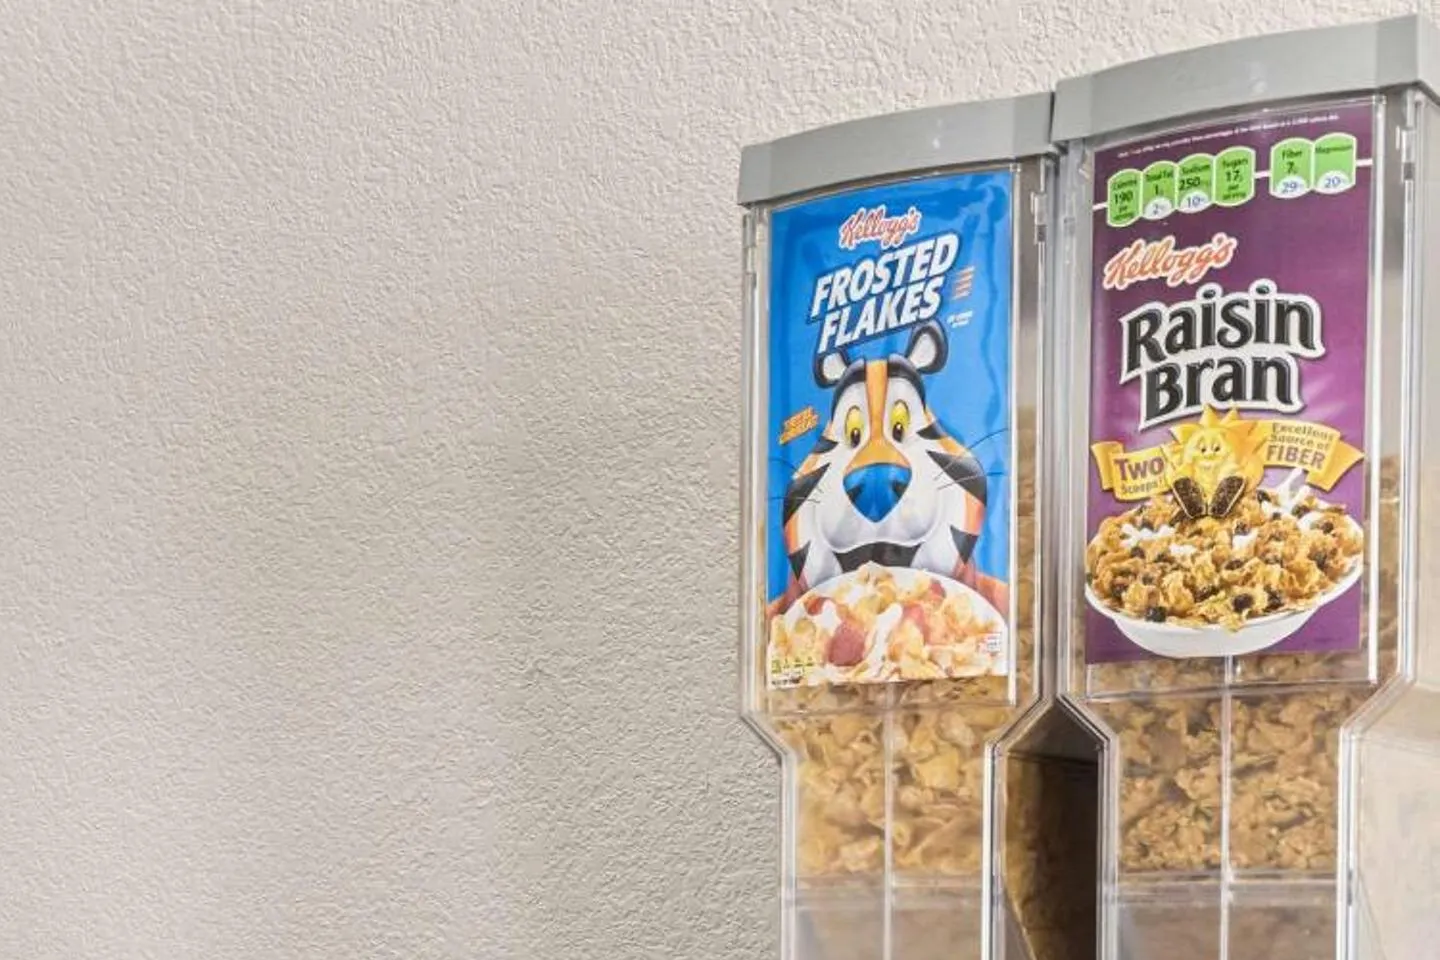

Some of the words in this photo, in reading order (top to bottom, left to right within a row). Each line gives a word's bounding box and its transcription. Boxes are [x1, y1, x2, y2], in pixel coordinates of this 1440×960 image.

[840, 205, 921, 248] Kellogg's
[812, 233, 959, 318] FROSTED
[1104, 233, 1236, 288] Kellogg's
[817, 275, 945, 355] FLAKES
[1124, 283, 1320, 375] Raisin
[1144, 355, 1297, 422] Bran
[1265, 443, 1326, 471] FIBER
